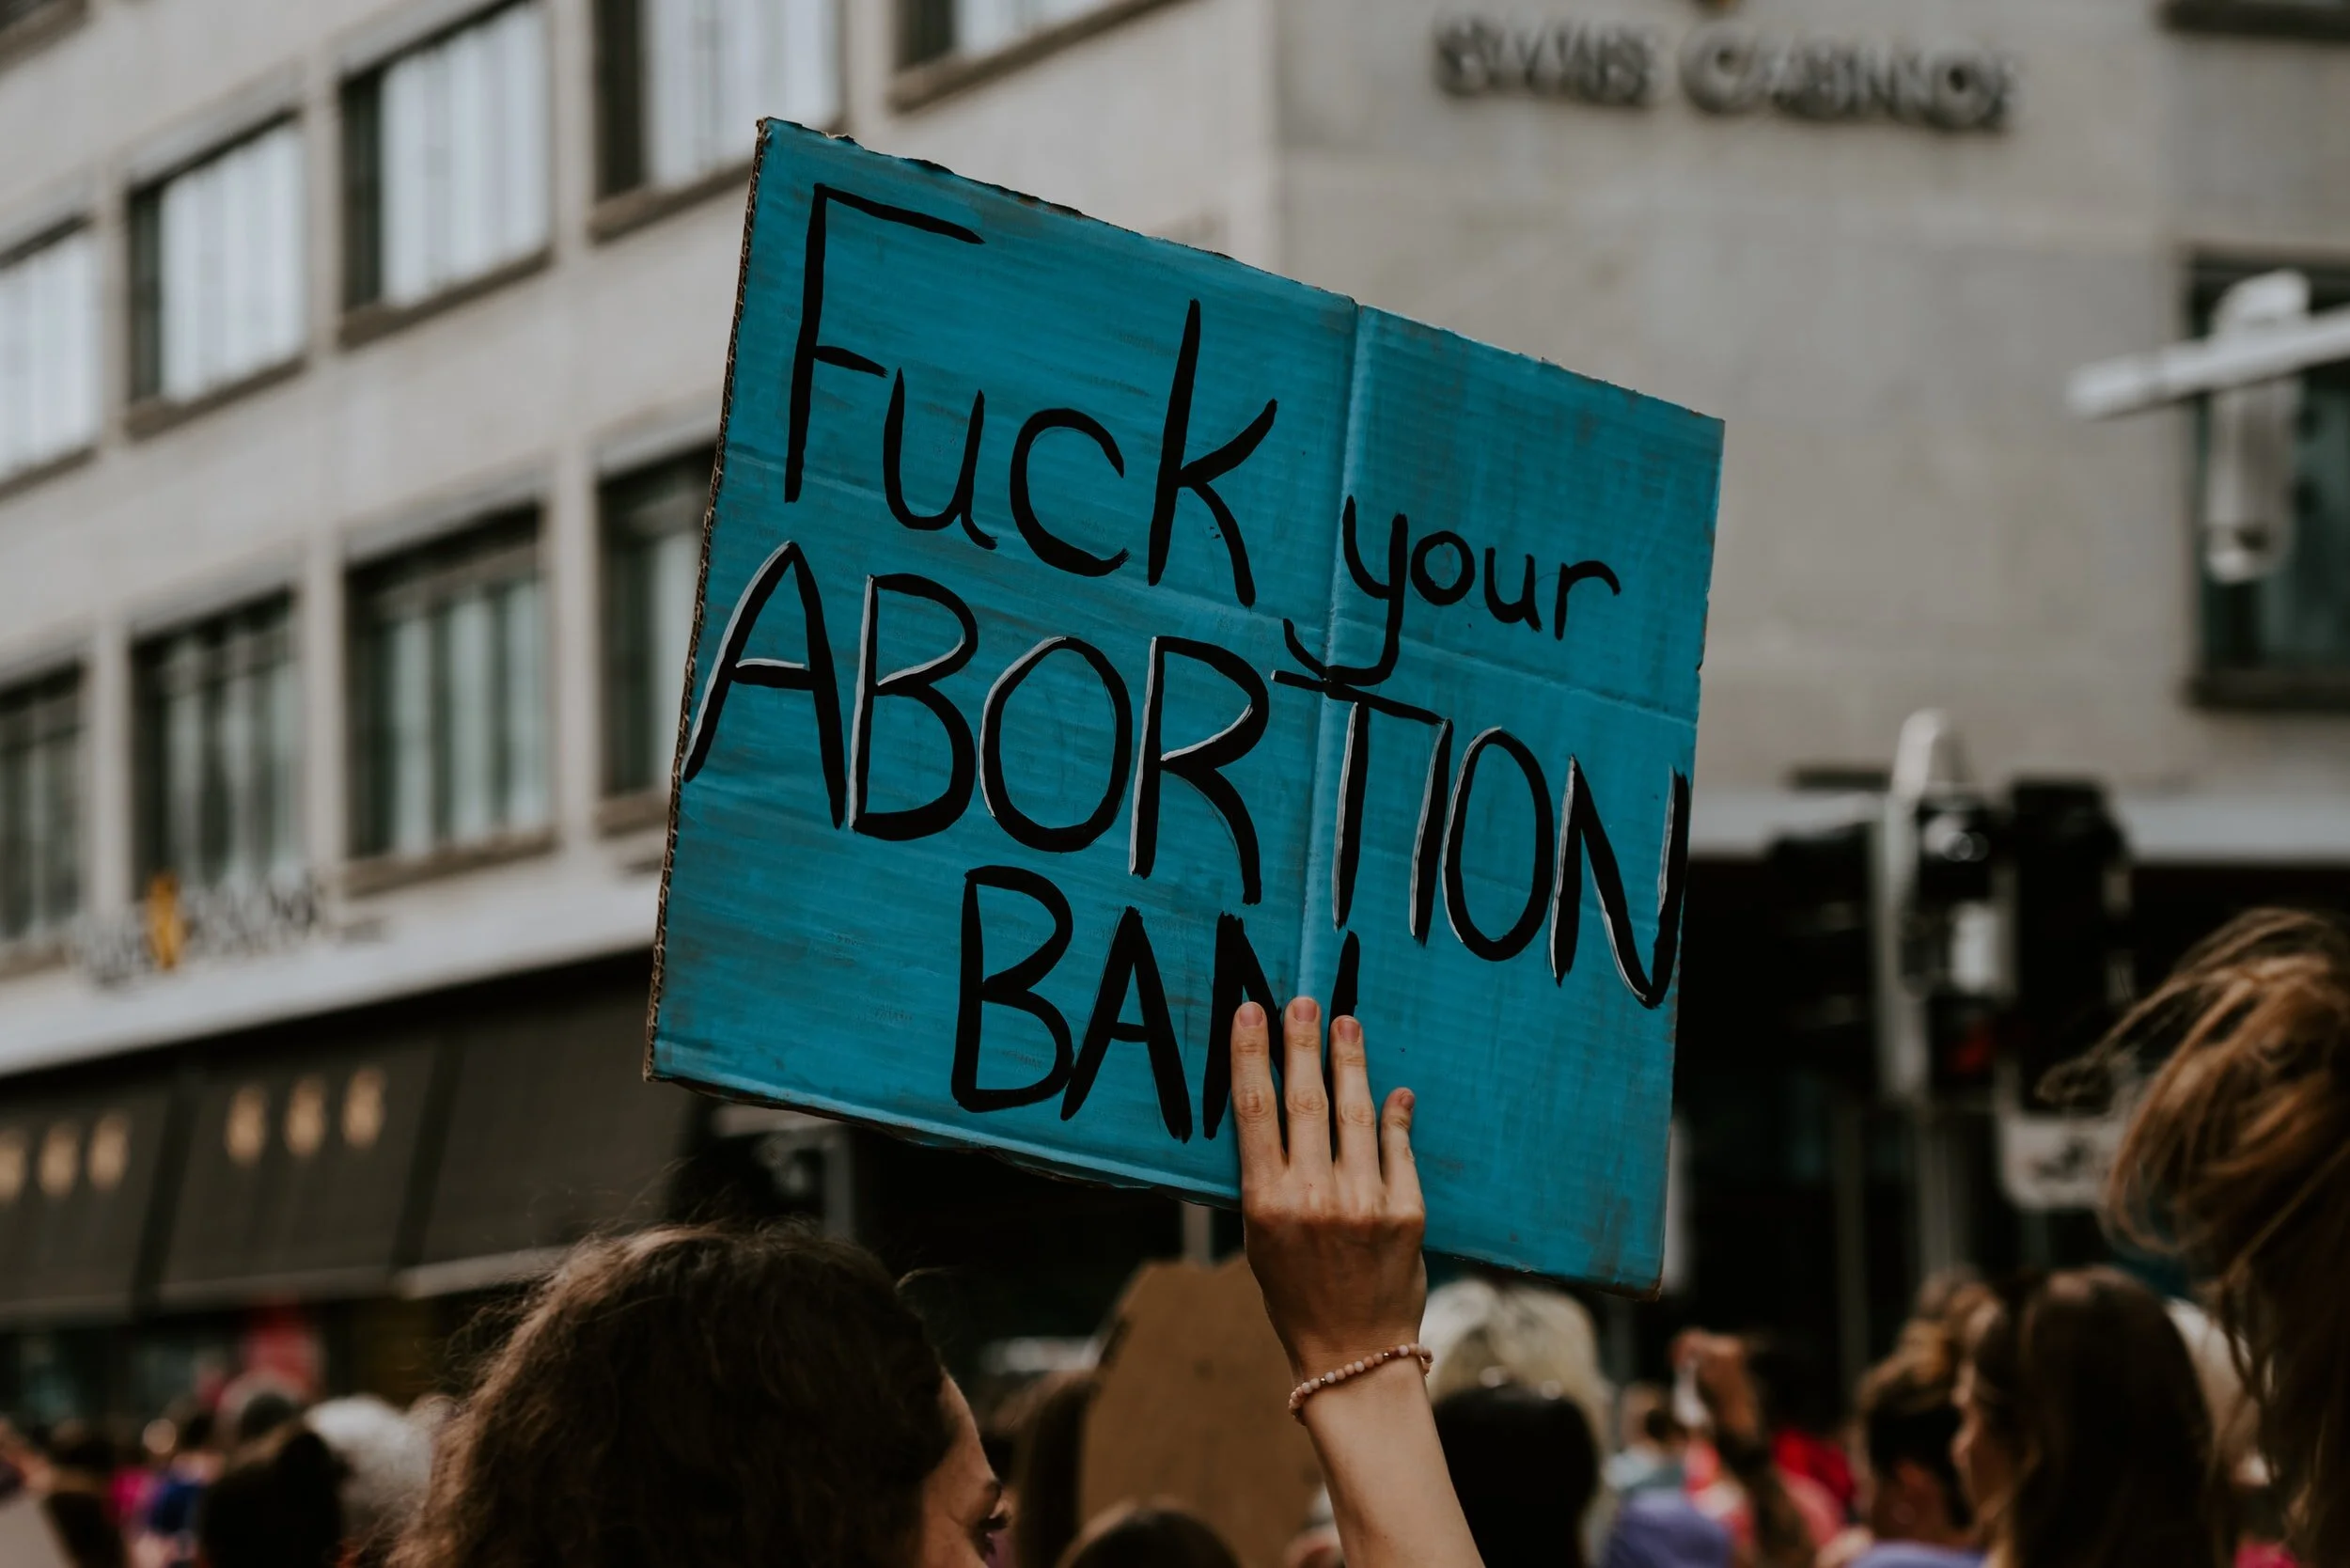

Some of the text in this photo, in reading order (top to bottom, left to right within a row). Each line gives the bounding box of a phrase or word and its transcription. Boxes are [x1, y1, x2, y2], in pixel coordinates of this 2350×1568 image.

[785, 182, 1622, 687] Fuck your
[682, 541, 1690, 1010] ABORTION
[951, 865, 1360, 1152] BAN
